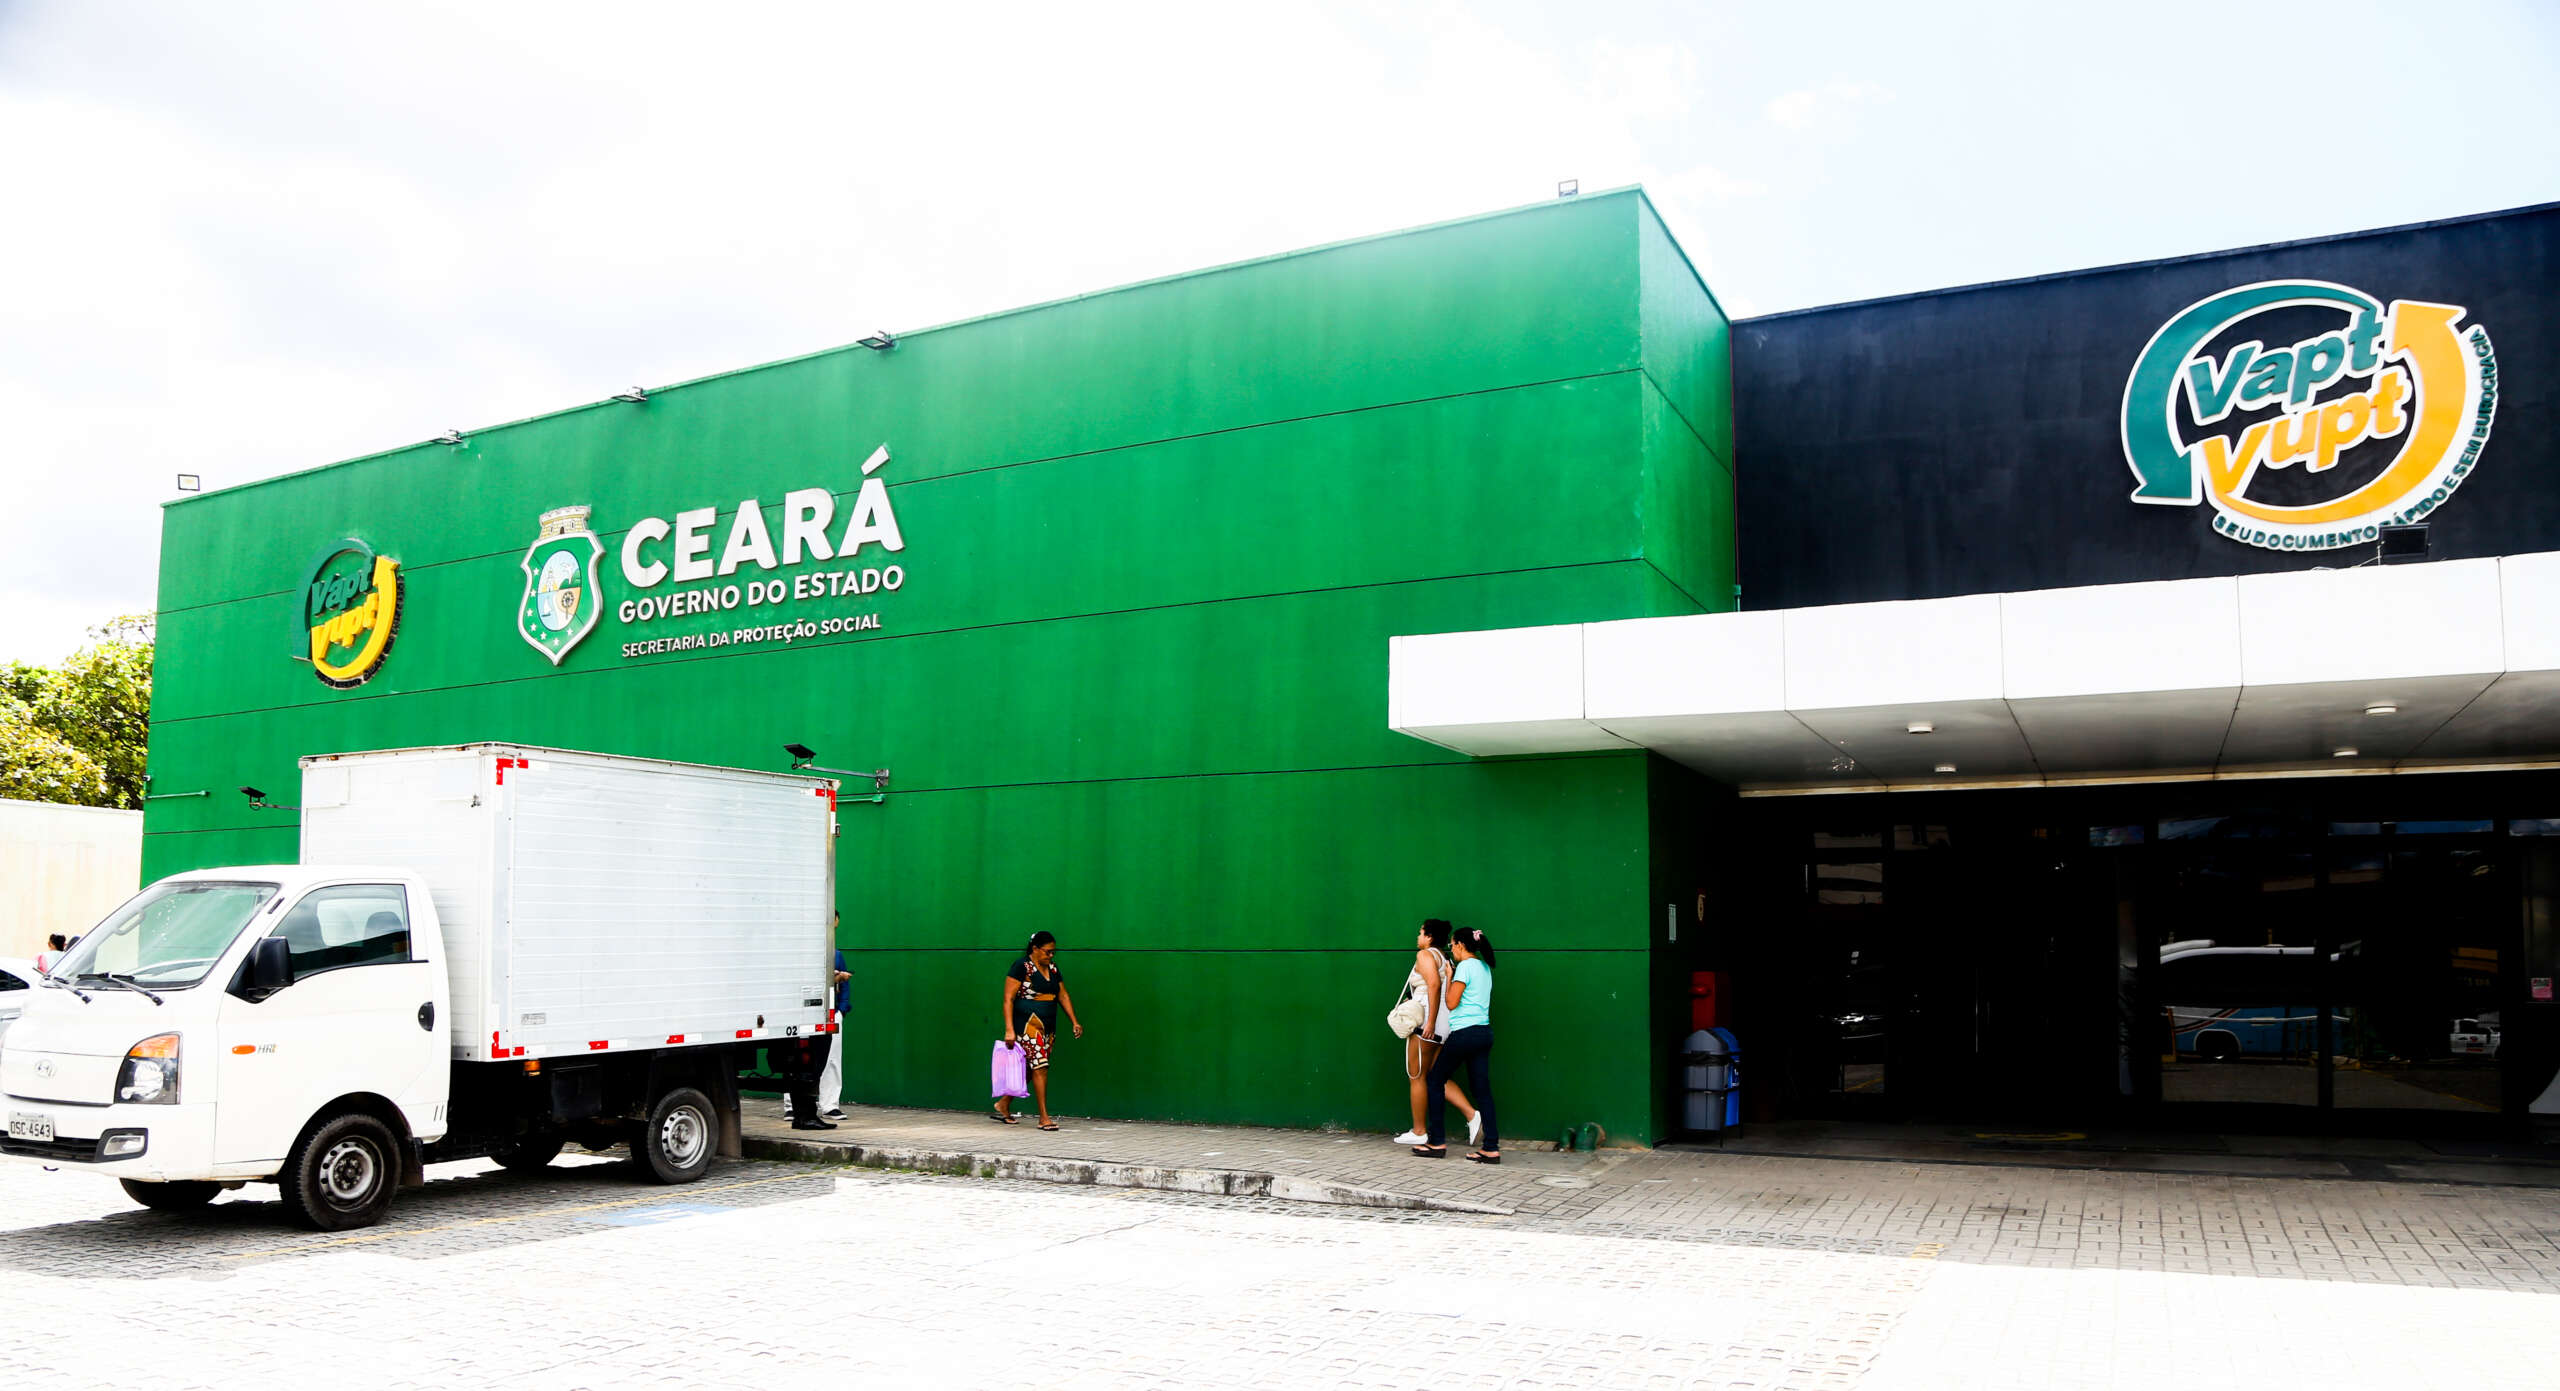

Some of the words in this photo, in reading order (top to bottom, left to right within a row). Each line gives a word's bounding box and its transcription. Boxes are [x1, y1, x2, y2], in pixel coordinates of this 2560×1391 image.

[2189, 309, 2383, 419] Vapt
[2202, 372, 2406, 493] Vupt
[620, 445, 905, 588] CEARÁ
[2378, 488, 2448, 526] ÁPIDO
[2442, 475, 2459, 490] E
[2453, 439, 2482, 478] SEM
[311, 563, 372, 617] Vapt
[618, 585, 741, 624] GOVERNO
[747, 579, 787, 606] DO
[793, 565, 905, 600] ESTADO
[310, 592, 379, 660] Vupt
[622, 634, 706, 658] SECRETARIA
[709, 631, 730, 648] DA
[733, 619, 817, 644] PROTEÇÃO
[820, 613, 882, 634] SOCIAL
[785, 1025, 798, 1036] 02
